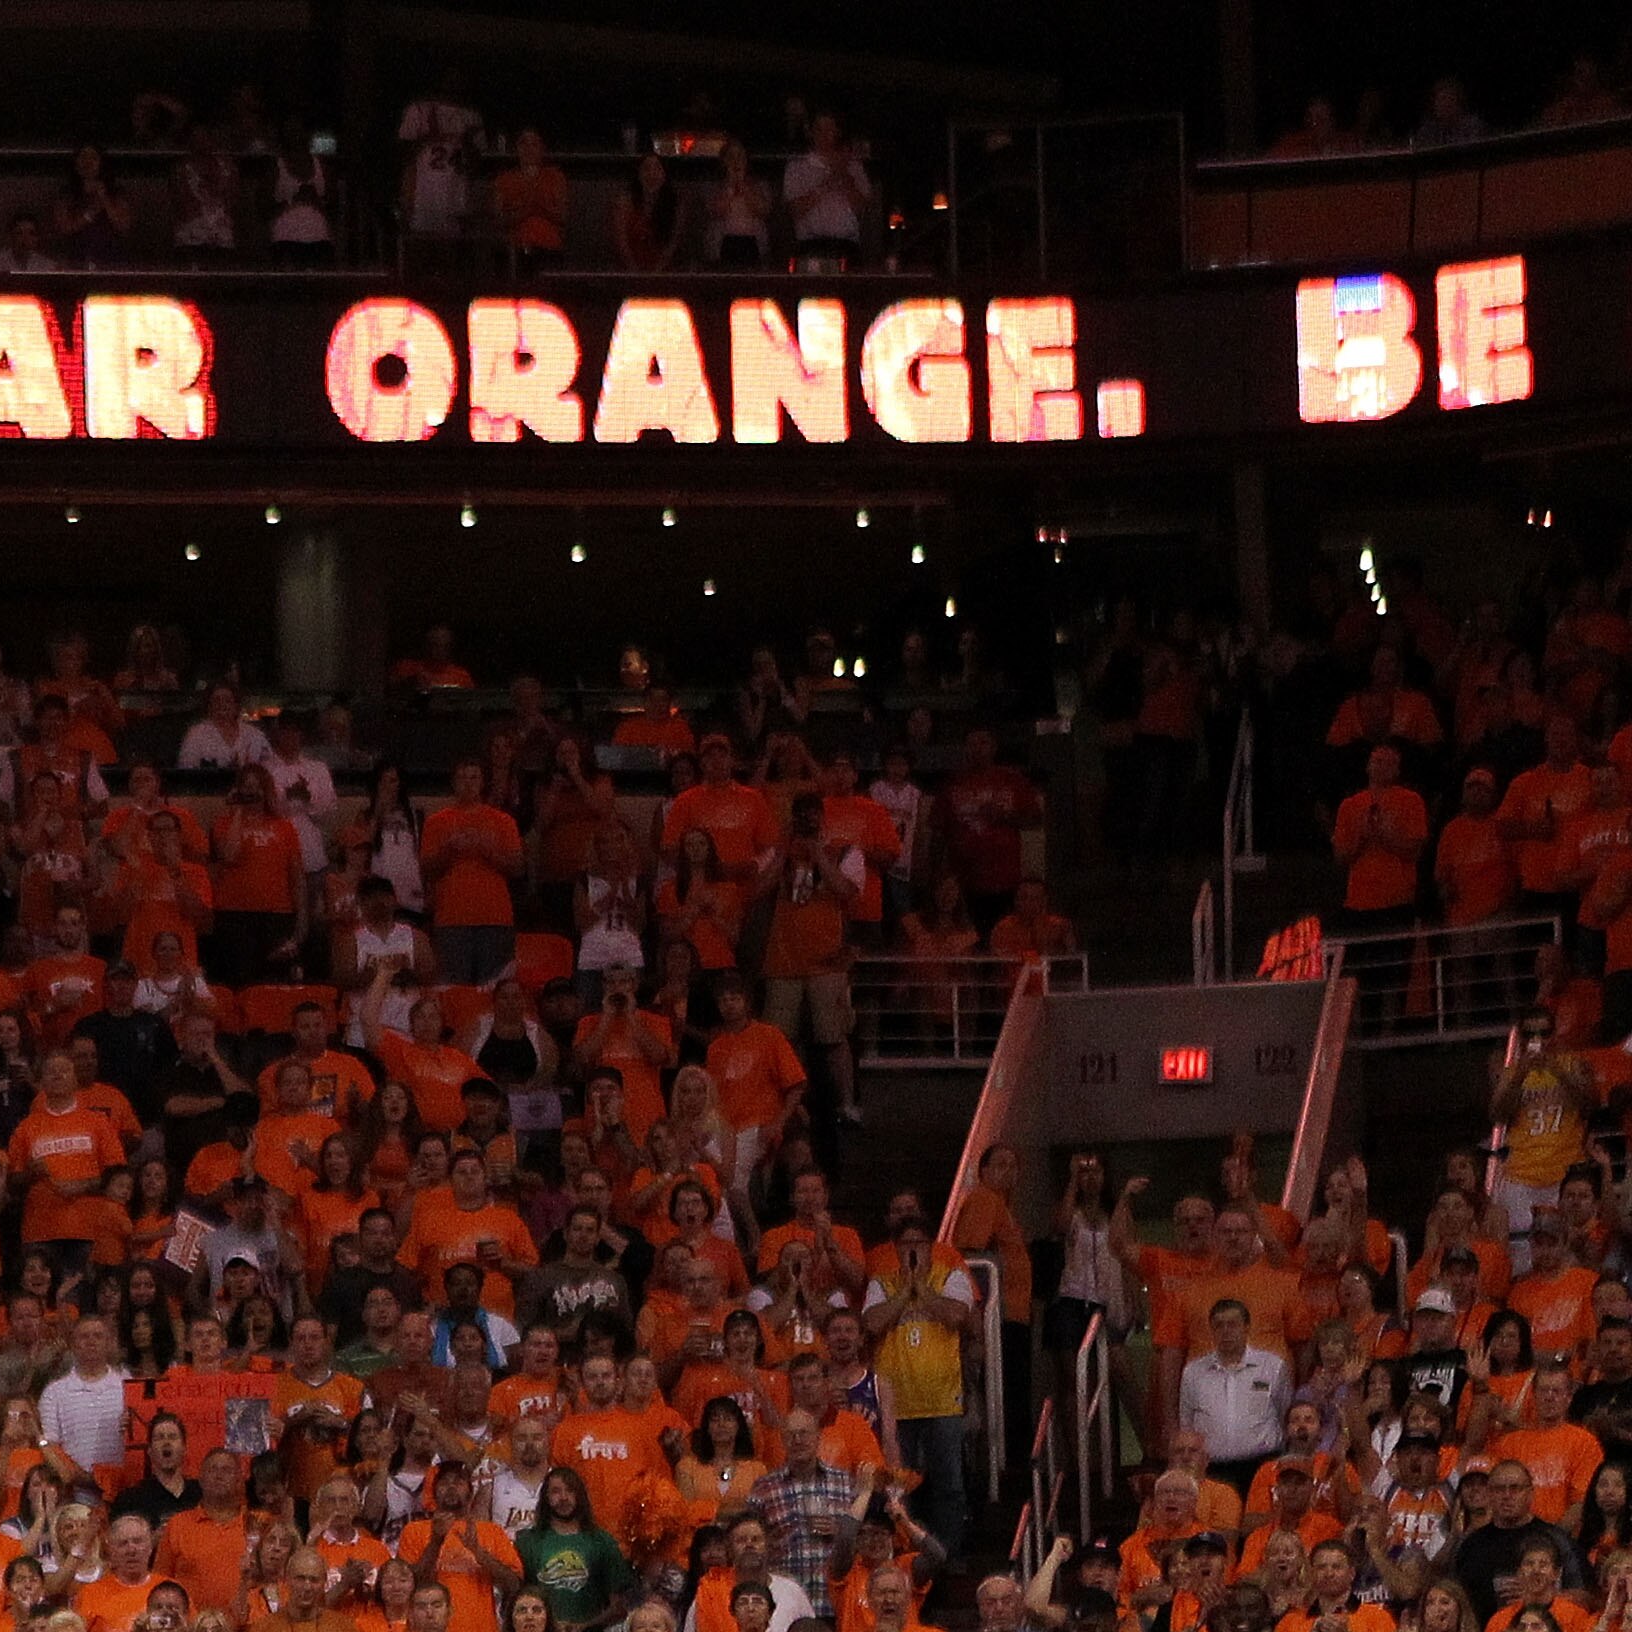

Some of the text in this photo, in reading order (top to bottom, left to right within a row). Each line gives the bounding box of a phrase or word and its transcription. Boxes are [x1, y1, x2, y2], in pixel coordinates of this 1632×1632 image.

[324, 297, 1144, 443] ORANGE.
[1295, 254, 1534, 422] BE
[1528, 1104, 1564, 1137] 37
